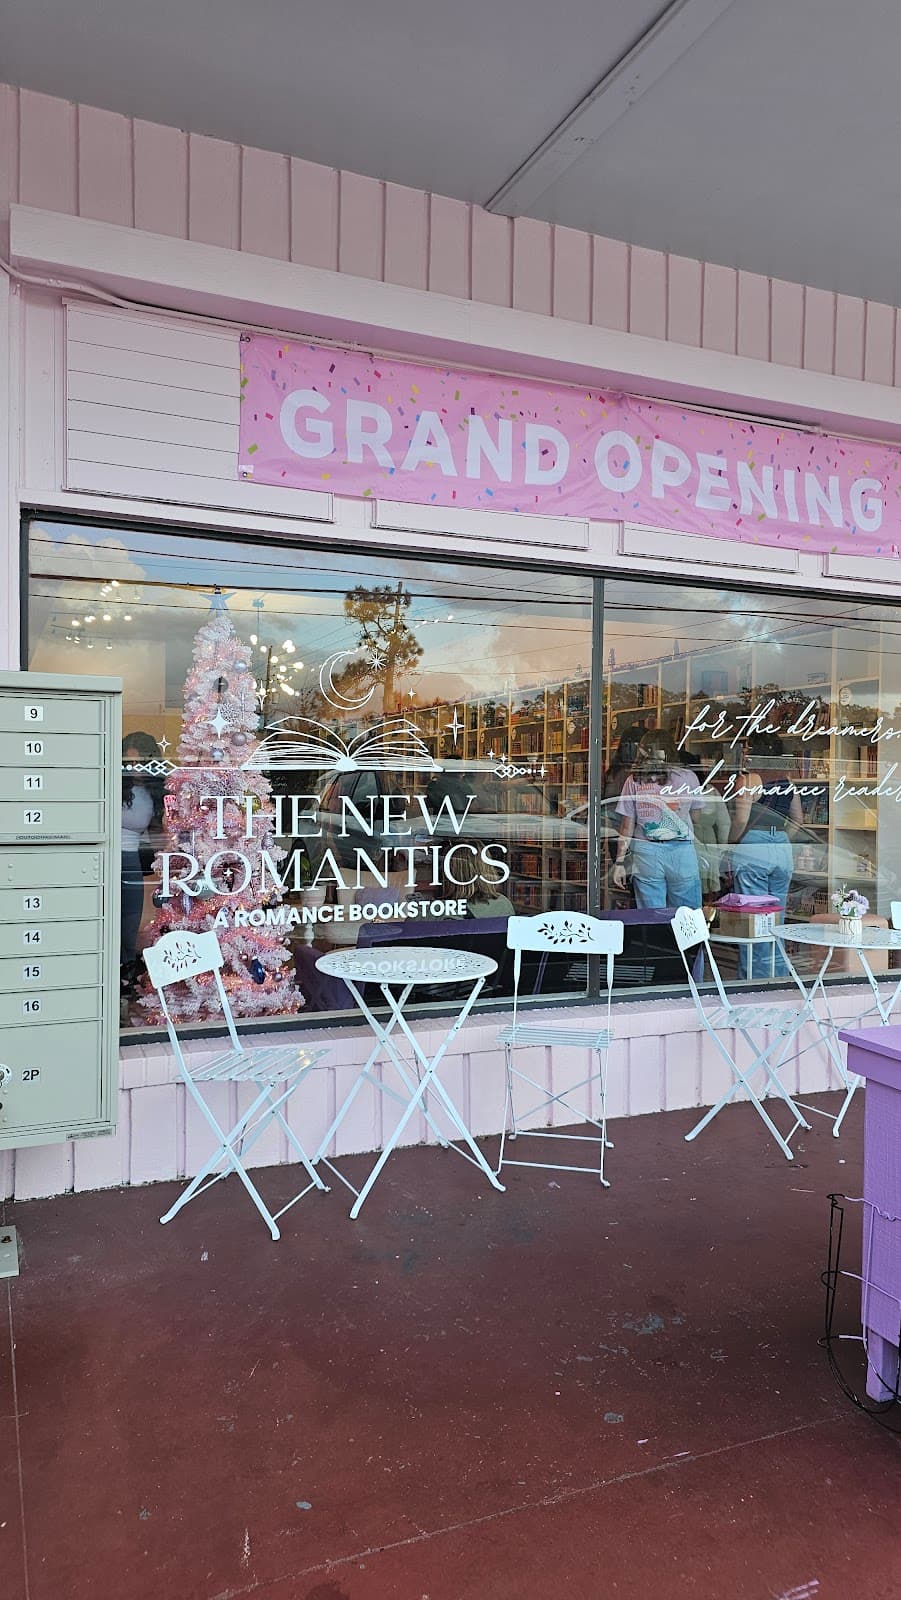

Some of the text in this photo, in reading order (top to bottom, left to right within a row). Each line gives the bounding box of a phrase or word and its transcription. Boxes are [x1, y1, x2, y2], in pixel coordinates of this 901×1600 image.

[279, 388, 883, 532] GRAND OPENING
[30, 708, 38, 719] 9
[678, 704, 733, 751] for
[730, 698, 781, 750] the
[26, 742, 42, 753] 10
[26, 777, 41, 788] 11
[660, 759, 725, 796] and
[722, 774, 826, 802] romance
[25, 811, 41, 822] 12
[200, 794, 477, 840] THE NEW
[157, 842, 511, 898] ROMANTICS
[24, 897, 40, 909] 13
[213, 899, 468, 928] A ROMANCE BOOKSTORE
[24, 931, 40, 943] 14
[24, 966, 40, 977] 15
[24, 1000, 40, 1011] 16
[22, 1069, 39, 1081] 2P
